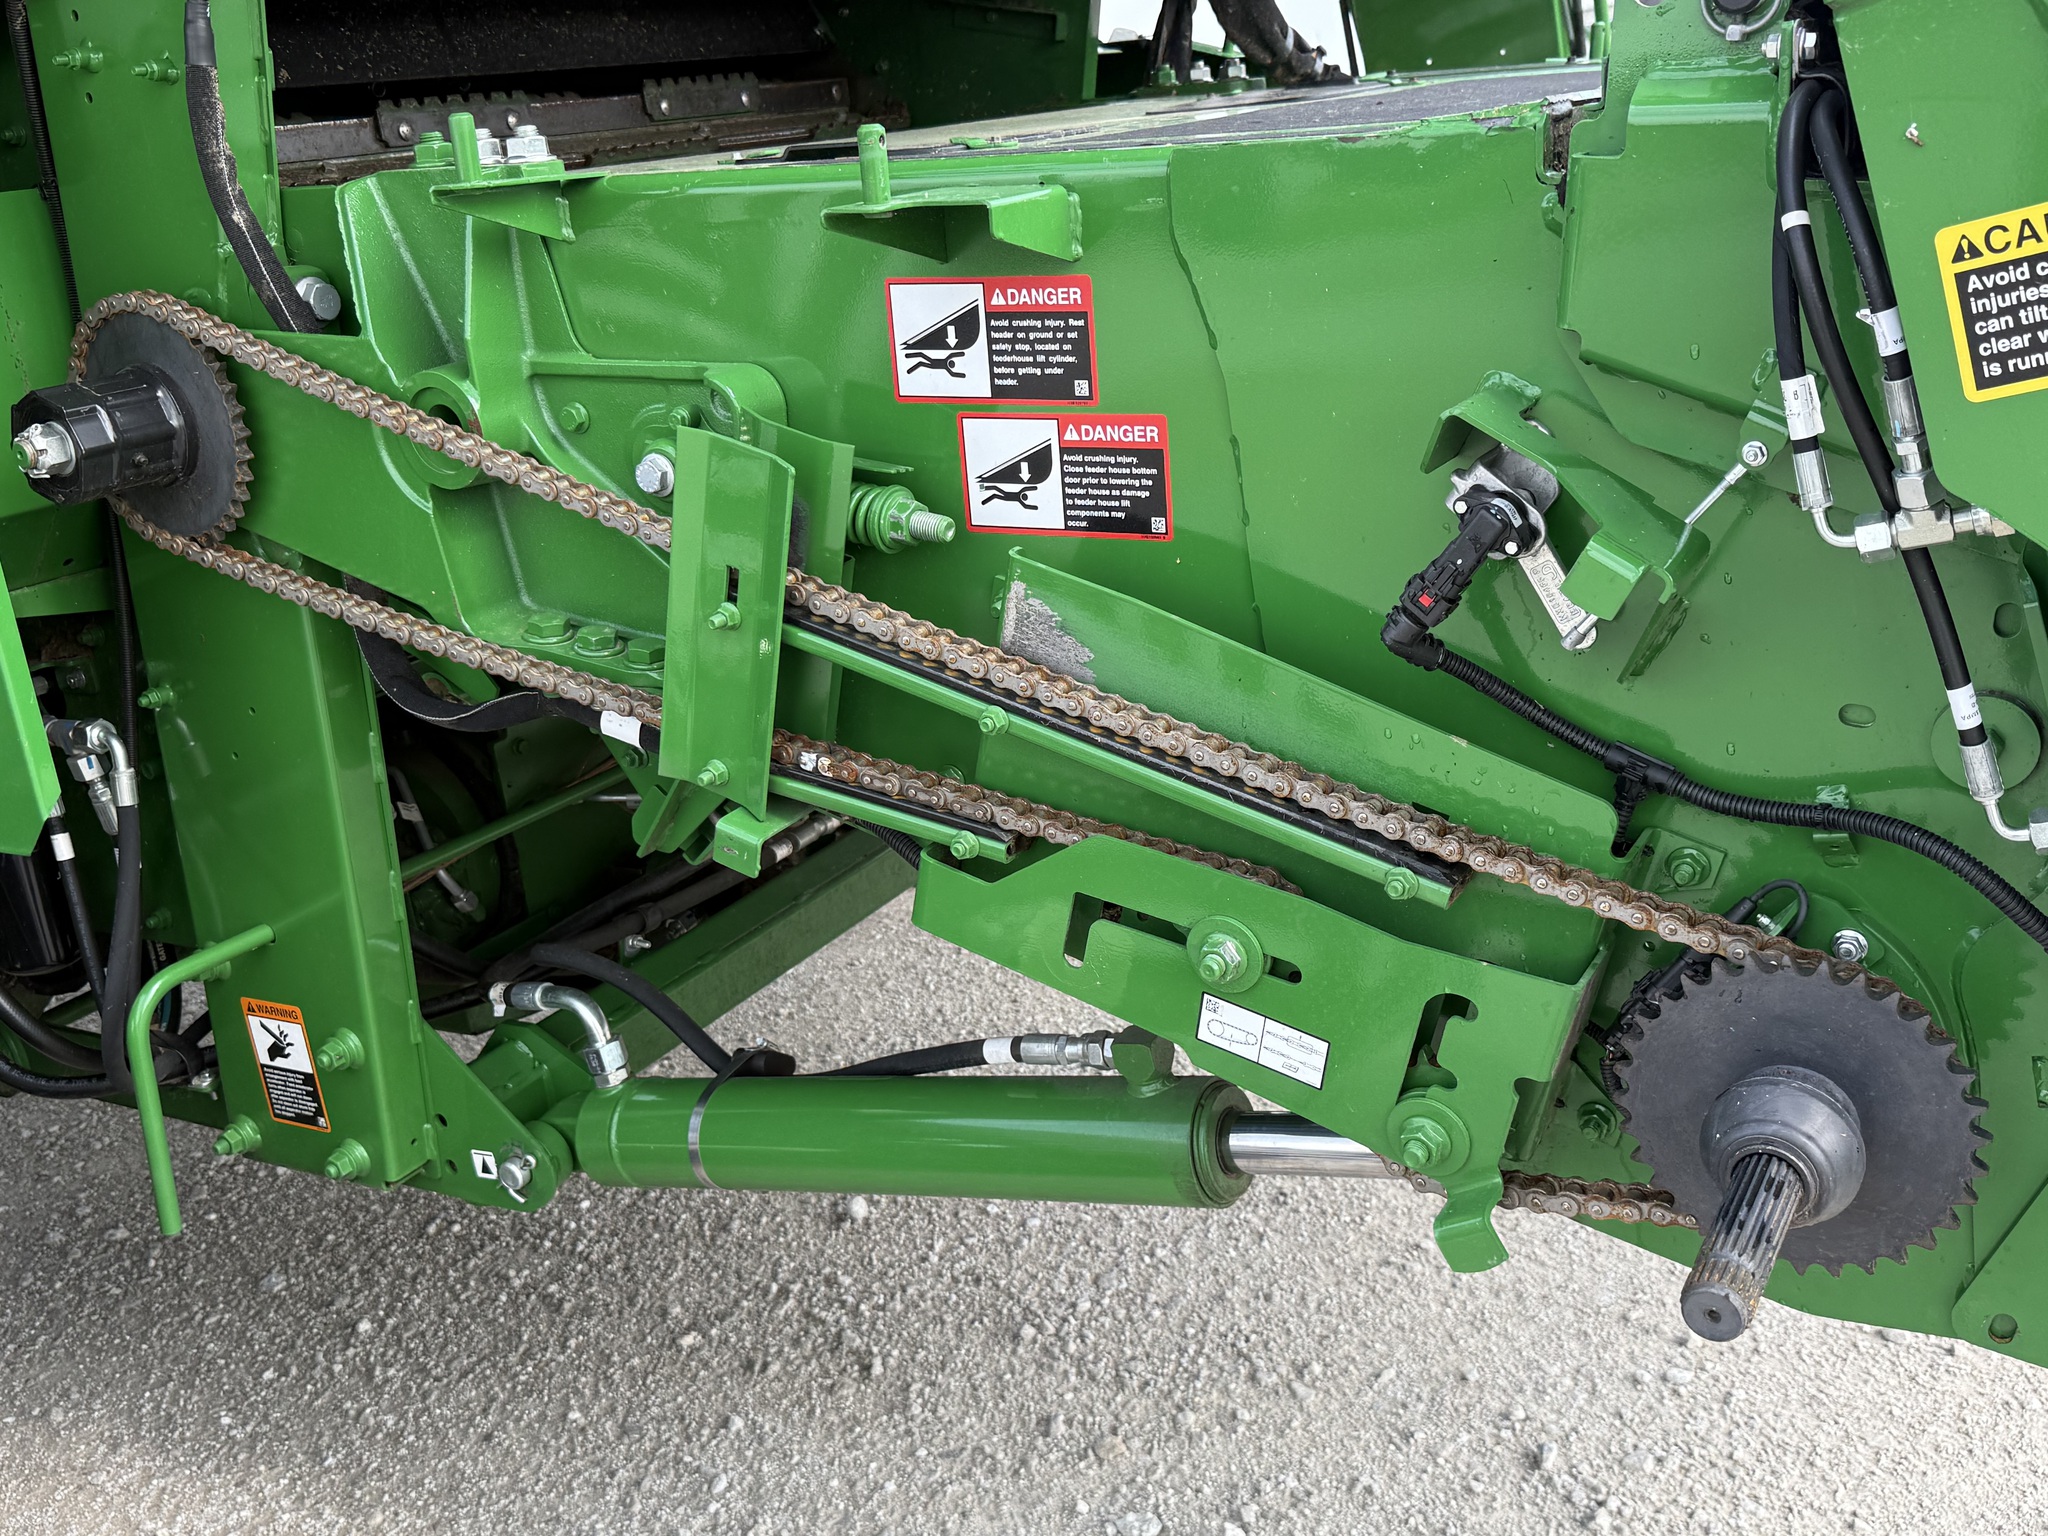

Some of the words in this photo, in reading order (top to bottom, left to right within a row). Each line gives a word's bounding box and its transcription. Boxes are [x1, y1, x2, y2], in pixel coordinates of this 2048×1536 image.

[1984, 213, 2048, 254] CA
[1967, 262, 2031, 293] Avoid
[1007, 287, 1082, 305] DANGER
[1969, 283, 2048, 314] injuries
[990, 319, 1009, 327] Avoid
[1012, 319, 1042, 328] crushing
[1068, 318, 1085, 327] Rest
[1974, 316, 2014, 336] can
[2018, 304, 2048, 325] tilt
[990, 331, 1014, 339] header
[1029, 331, 1053, 340] ground
[1067, 331, 1078, 339] set
[991, 343, 1012, 352] safety
[1015, 343, 1032, 352] stop,
[1034, 342, 1060, 351] located
[1978, 333, 2032, 357] clear
[992, 354, 1034, 362] feederhouse
[1036, 354, 1046, 362] lift
[1048, 354, 1078, 364] cylinder,
[993, 366, 1015, 374] before
[1017, 366, 1042, 376] getting
[1982, 361, 2002, 378] is
[994, 378, 1019, 386] header.
[1081, 424, 1159, 443] DANGER
[1063, 454, 1083, 462] Avoid
[1084, 455, 1116, 464] crushing
[1063, 465, 1084, 473] Close
[1085, 465, 1107, 474] feeder
[1108, 466, 1130, 474] house
[1132, 467, 1158, 475] bottom
[1064, 476, 1081, 484] door
[1082, 476, 1099, 486] prior
[1100, 477, 1108, 485] to
[1109, 477, 1140, 488] lowering
[1141, 478, 1153, 486] the
[1065, 487, 1087, 495] feeder
[1088, 487, 1110, 496] house
[1121, 489, 1150, 499] damage
[1074, 498, 1097, 507] feeder
[1097, 499, 1120, 507] house
[1120, 499, 1131, 508] lift
[1066, 509, 1110, 518] components
[1110, 511, 1126, 520] may
[1067, 520, 1089, 528] occur.
[256, 1003, 299, 1020] WARNING
